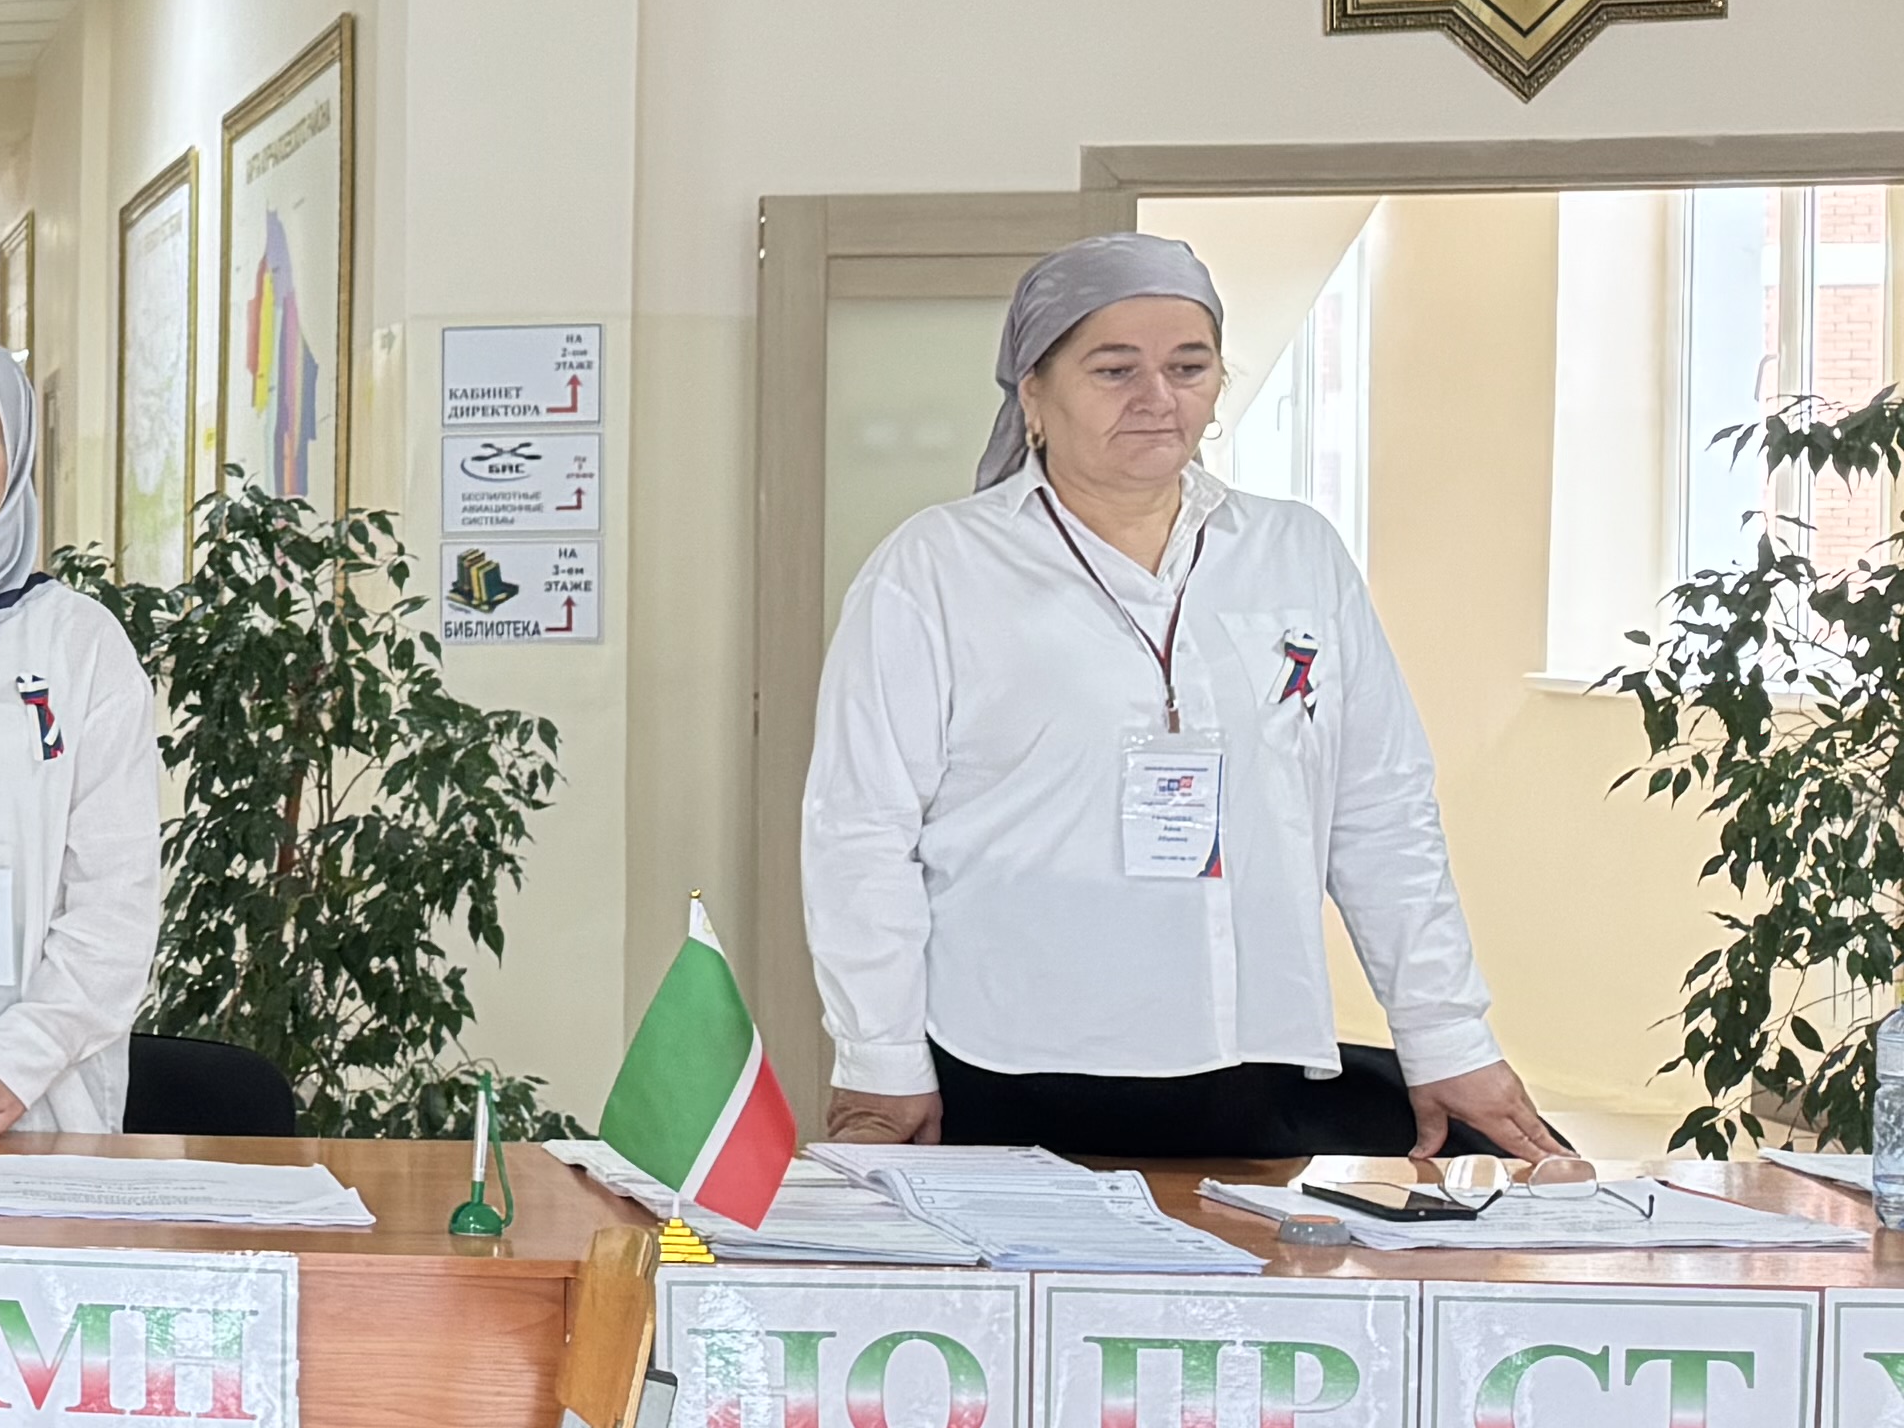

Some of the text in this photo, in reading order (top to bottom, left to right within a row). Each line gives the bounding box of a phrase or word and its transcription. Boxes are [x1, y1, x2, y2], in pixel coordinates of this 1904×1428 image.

[448, 387, 523, 401] КАБИНЕТ
[448, 404, 540, 419] ДИРЕКТОРА
[461, 491, 542, 502] БЕСПИЛОТНЫЕ
[461, 503, 544, 514] АВИАЦИОННЫЕ
[461, 515, 515, 526] СИСТЕМЫ
[558, 547, 578, 560] НА
[543, 580, 593, 592] ЭТАЖЕ
[444, 619, 542, 640] БИБЛИОТЕКА
